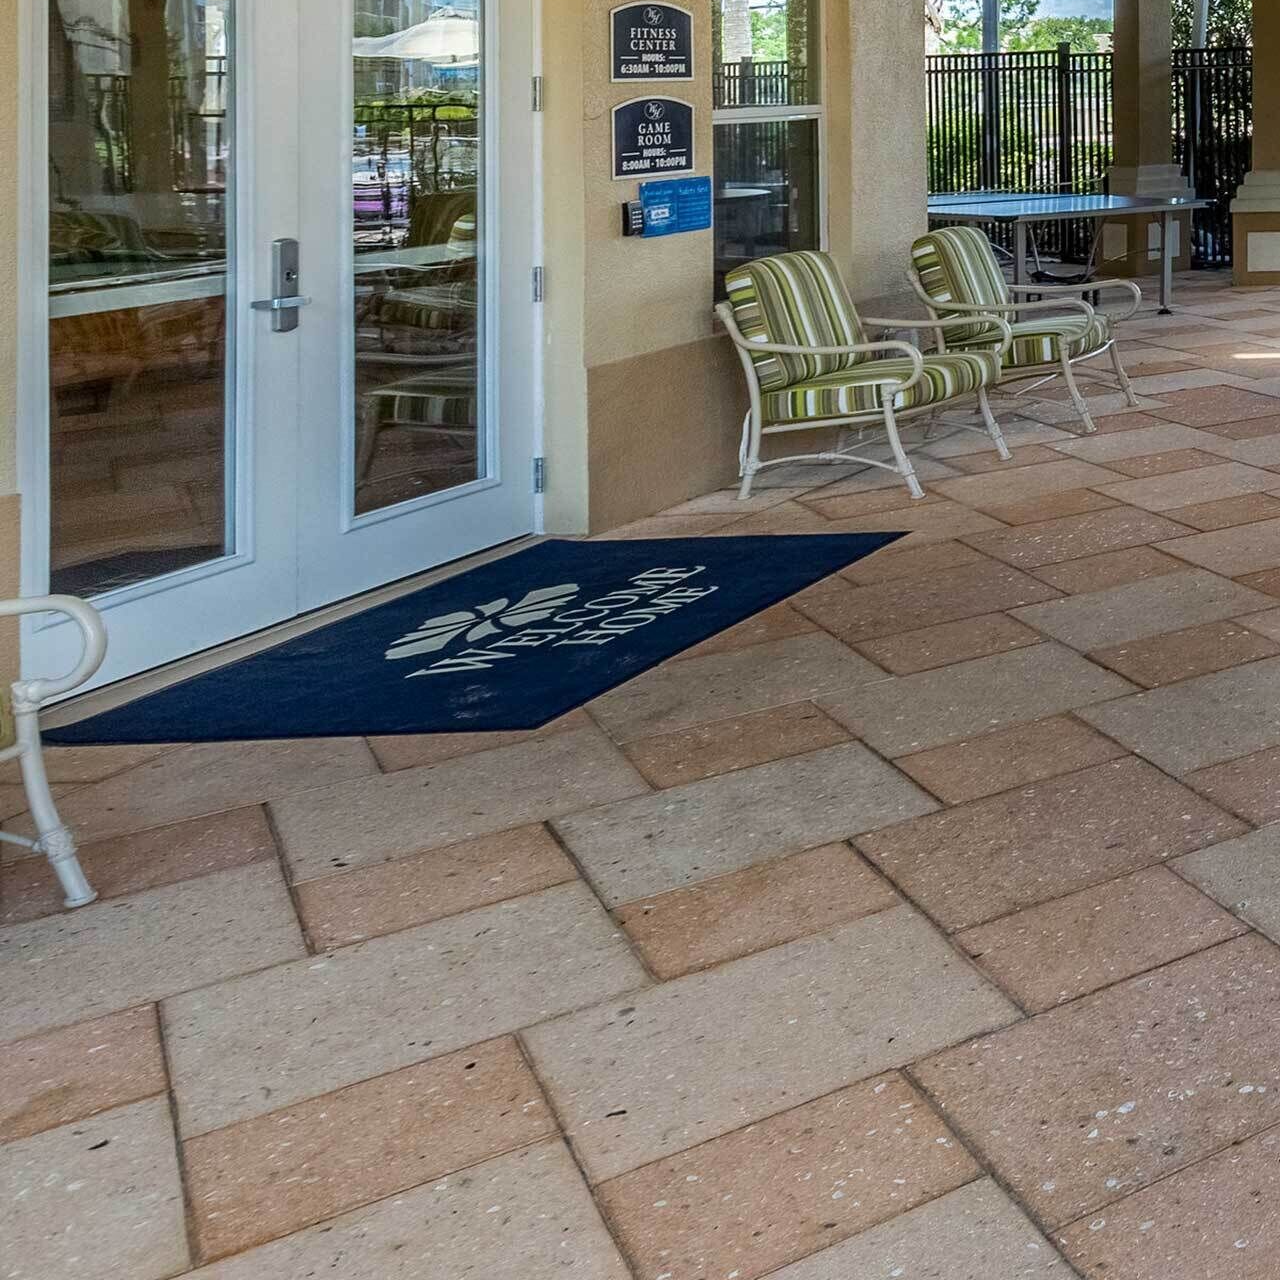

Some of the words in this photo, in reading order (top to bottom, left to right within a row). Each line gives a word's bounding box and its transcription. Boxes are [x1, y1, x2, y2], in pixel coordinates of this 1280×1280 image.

[630, 27, 677, 40] FITNESS
[630, 39, 676, 52] CENTER
[638, 122, 671, 135] GAME
[637, 133, 672, 146] ROOM
[404, 565, 706, 679] WELCOME
[552, 585, 719, 648] HOME
